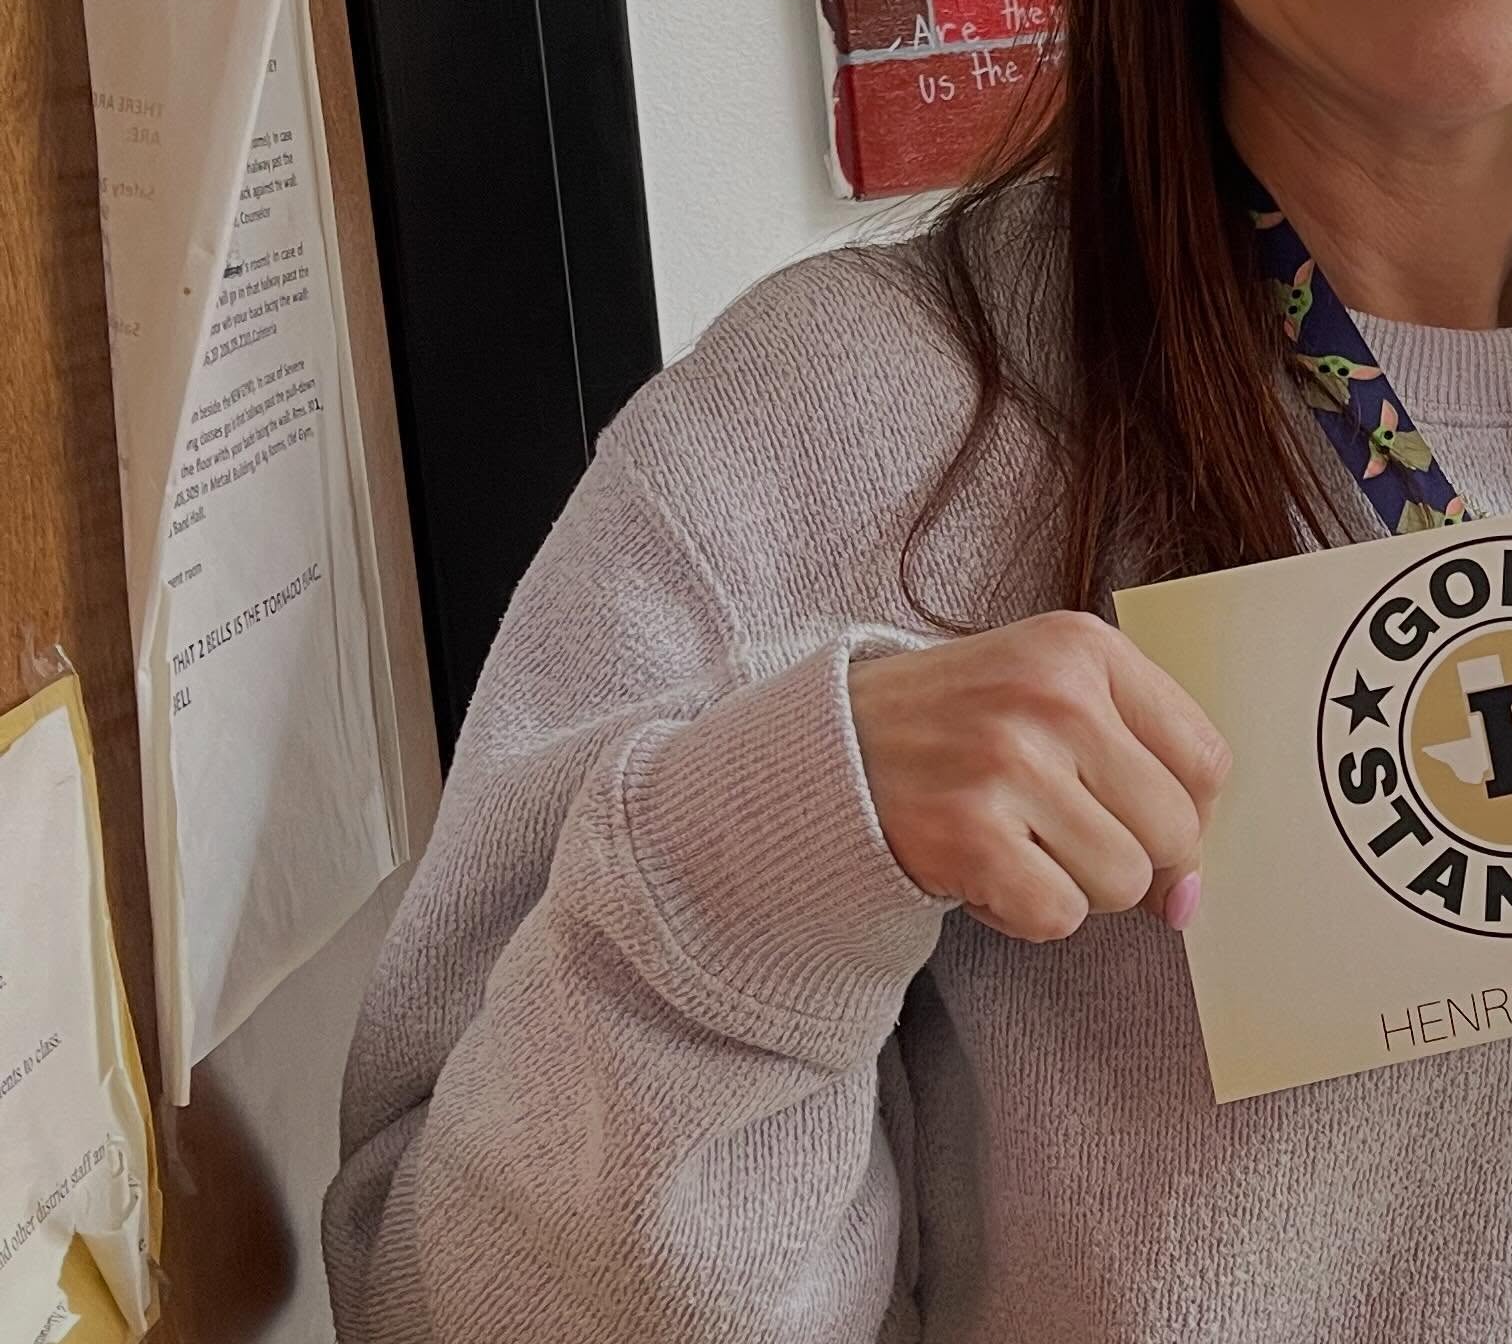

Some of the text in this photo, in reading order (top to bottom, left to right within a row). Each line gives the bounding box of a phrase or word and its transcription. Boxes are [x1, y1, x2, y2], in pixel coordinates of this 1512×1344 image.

[918, 73, 956, 105] us
[970, 47, 1024, 91] the
[172, 643, 195, 676] THAT
[205, 621, 234, 655] BELLS
[242, 603, 262, 630] THE
[262, 575, 301, 618] TORNADO
[11, 1213, 38, 1252] other
[36, 1176, 71, 1226] district
[70, 1149, 94, 1184] staff
